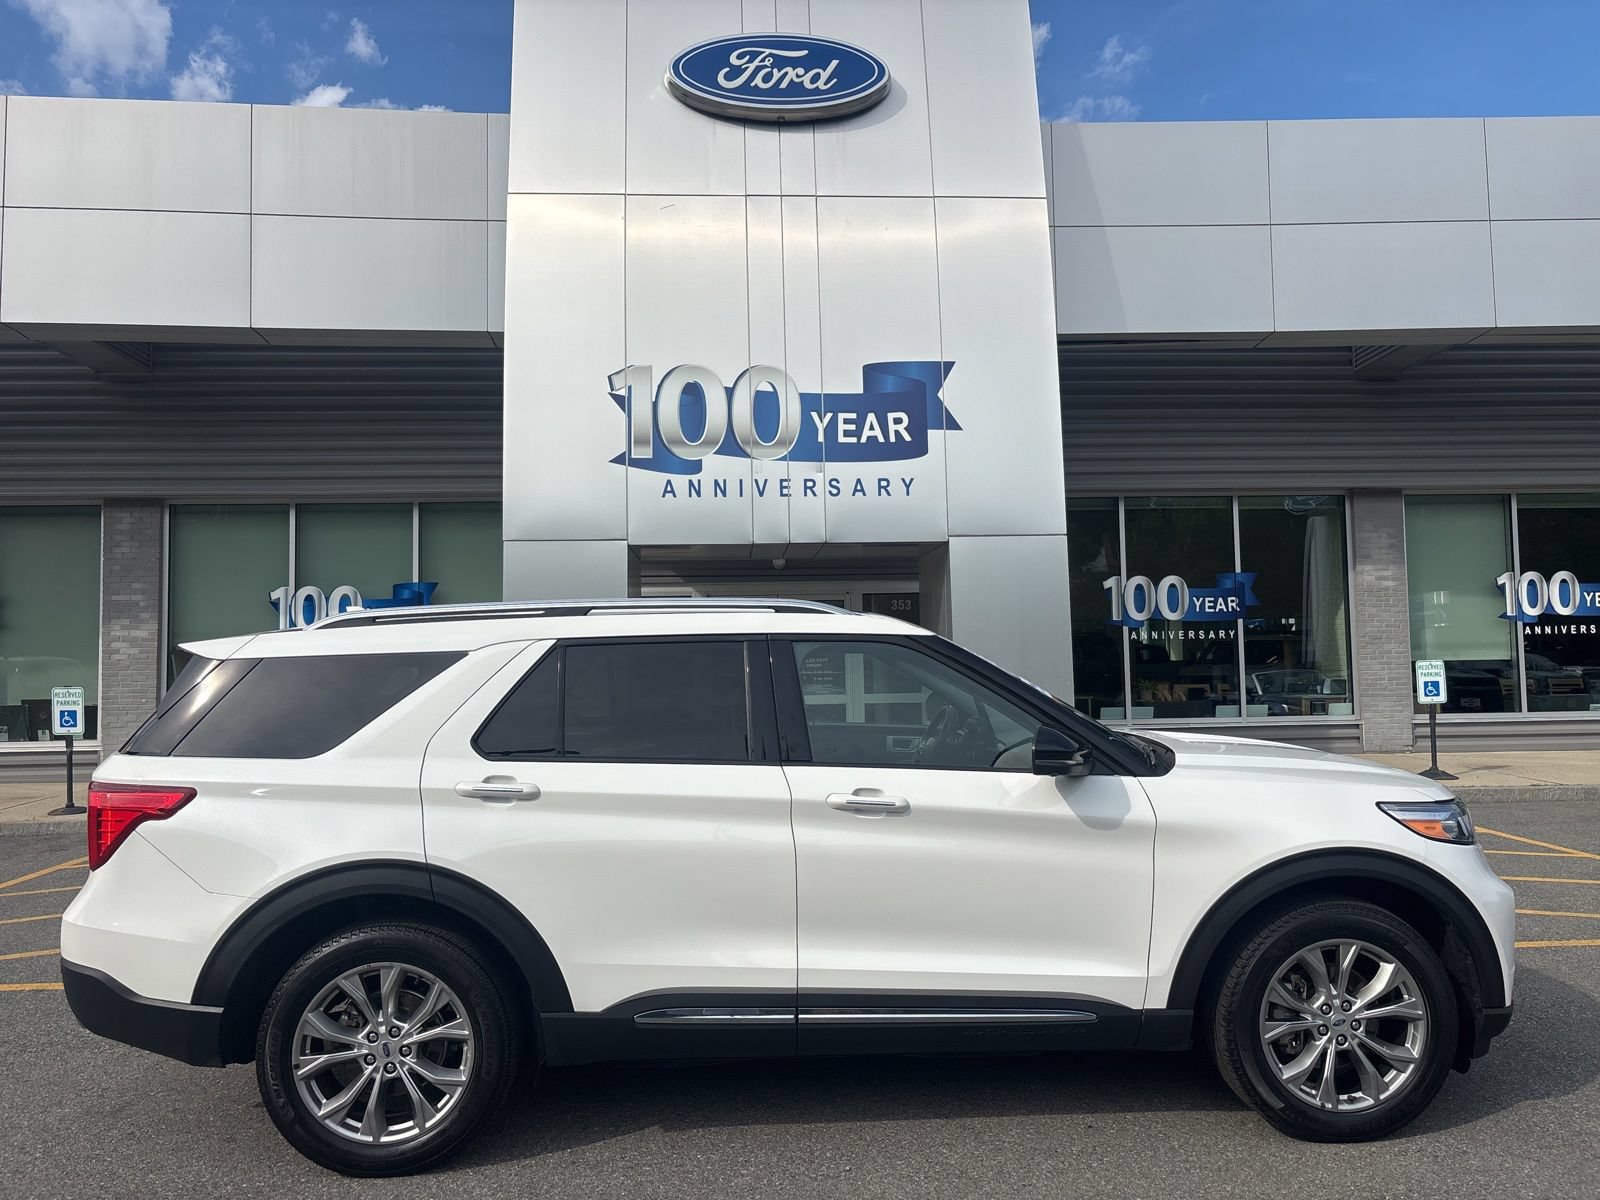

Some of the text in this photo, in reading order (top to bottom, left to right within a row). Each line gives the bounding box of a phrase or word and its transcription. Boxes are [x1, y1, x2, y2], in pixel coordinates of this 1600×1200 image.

[717, 47, 840, 90] Ford
[608, 363, 912, 461] 100 YEAR
[661, 478, 915, 498] ANNIVERSARY
[1102, 575, 1240, 621] 100 YEAR
[1496, 570, 1580, 616] 100
[891, 599, 912, 610] 353
[1130, 629, 1236, 640] ANNIVERSARY
[54, 691, 82, 699] RESERVED
[56, 699, 81, 707] PARKING
